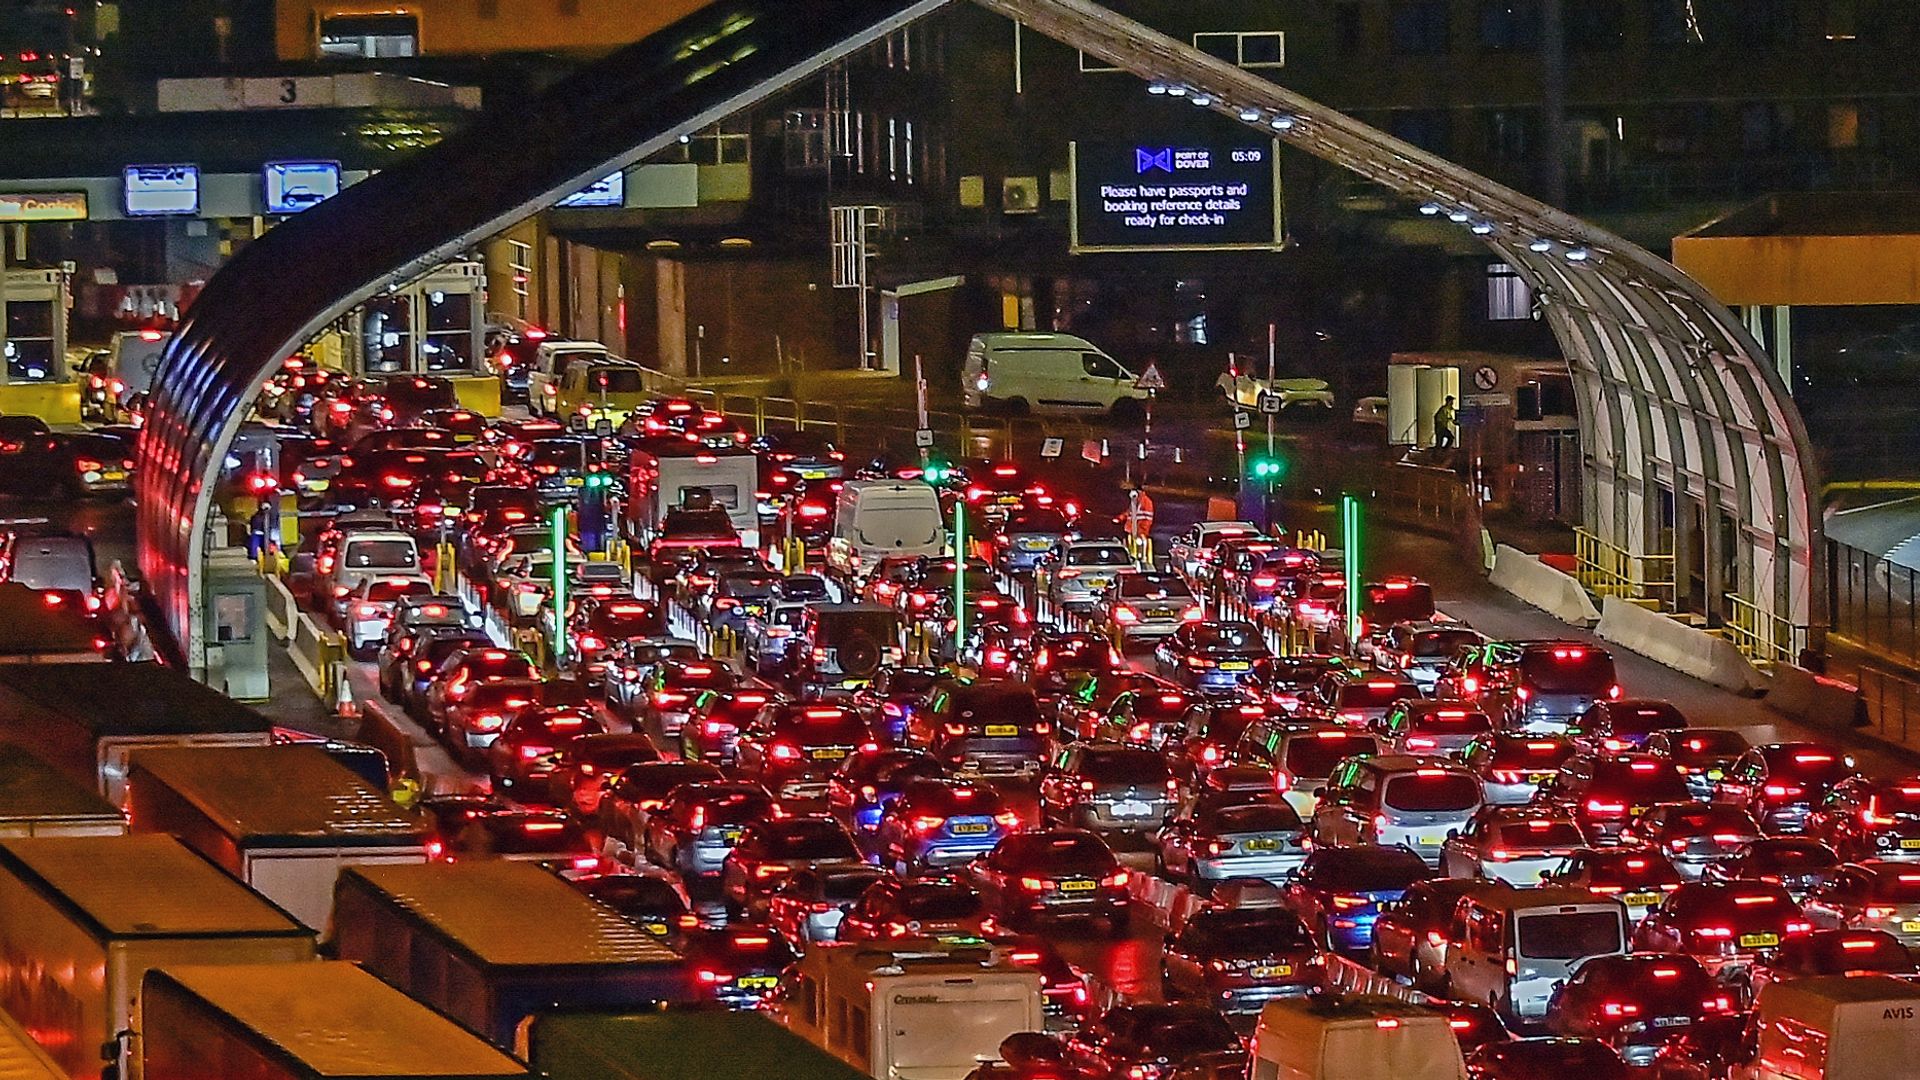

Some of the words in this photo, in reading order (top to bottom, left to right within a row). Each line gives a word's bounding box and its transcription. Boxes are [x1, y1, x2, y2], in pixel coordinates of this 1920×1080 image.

[280, 79, 297, 103] 3
[1174, 151, 1197, 160] PORT
[1231, 150, 1262, 162] 05:09
[1174, 159, 1210, 169] DOVER
[1100, 185, 1137, 198] Please
[1139, 184, 1167, 197] have
[1169, 184, 1224, 199] passports
[1226, 184, 1248, 196] and
[1103, 200, 1148, 213] booking
[1150, 199, 1203, 211] reference
[1204, 198, 1241, 211] details
[1124, 215, 1157, 228] ready
[1158, 213, 1176, 226] for
[1177, 213, 1225, 226] check-in
[1882, 1007, 1914, 1020] AVIS
